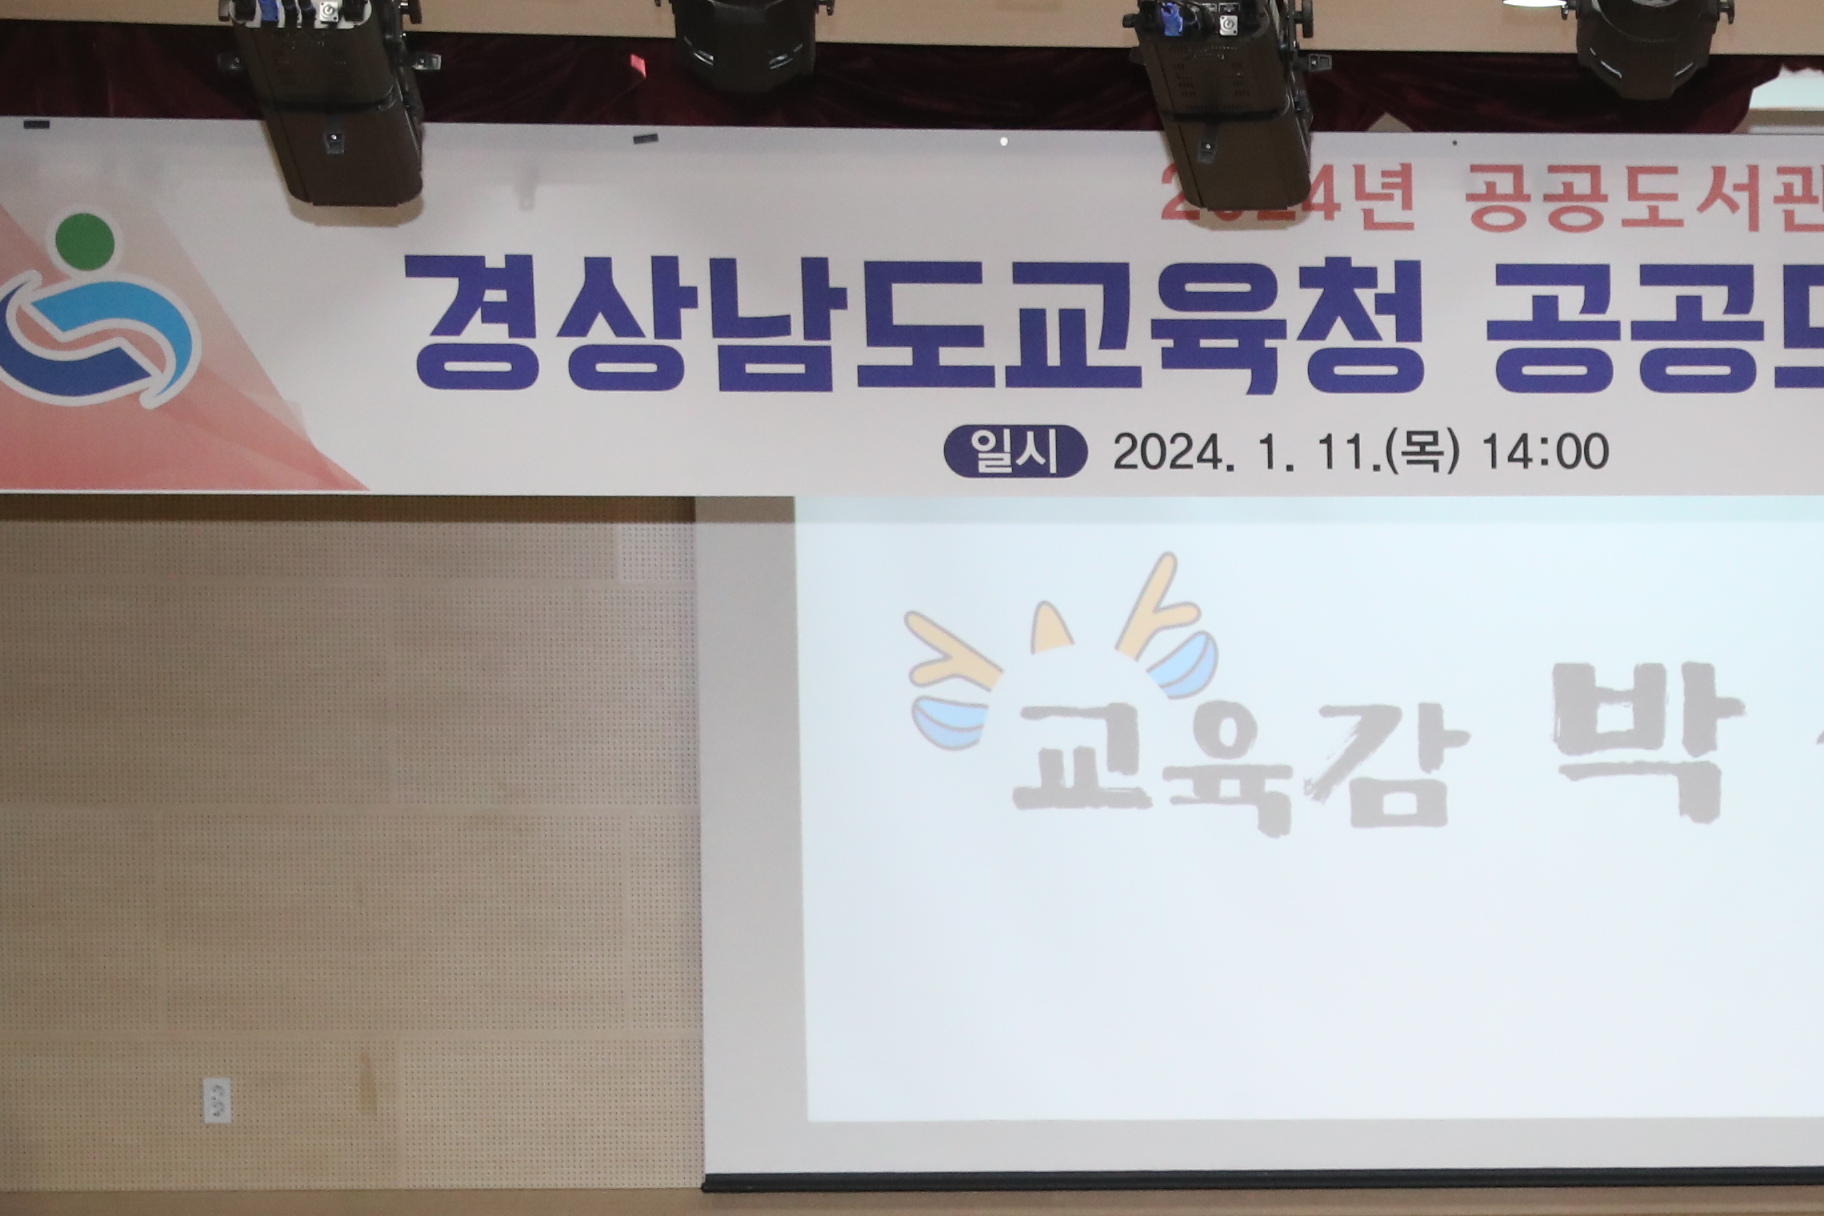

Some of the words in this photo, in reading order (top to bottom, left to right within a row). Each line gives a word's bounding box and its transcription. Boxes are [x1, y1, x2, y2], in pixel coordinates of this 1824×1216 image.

[1161, 162, 1415, 231] 24년
[404, 254, 1426, 396] 경상남도교육청
[970, 428, 1058, 475] 일시
[1113, 432, 1236, 473] 2024.
[1259, 433, 1296, 473] 1.
[1319, 427, 1461, 476] 11.(목)
[1483, 432, 1612, 472] 14:00
[1012, 700, 1472, 838] 교육감
